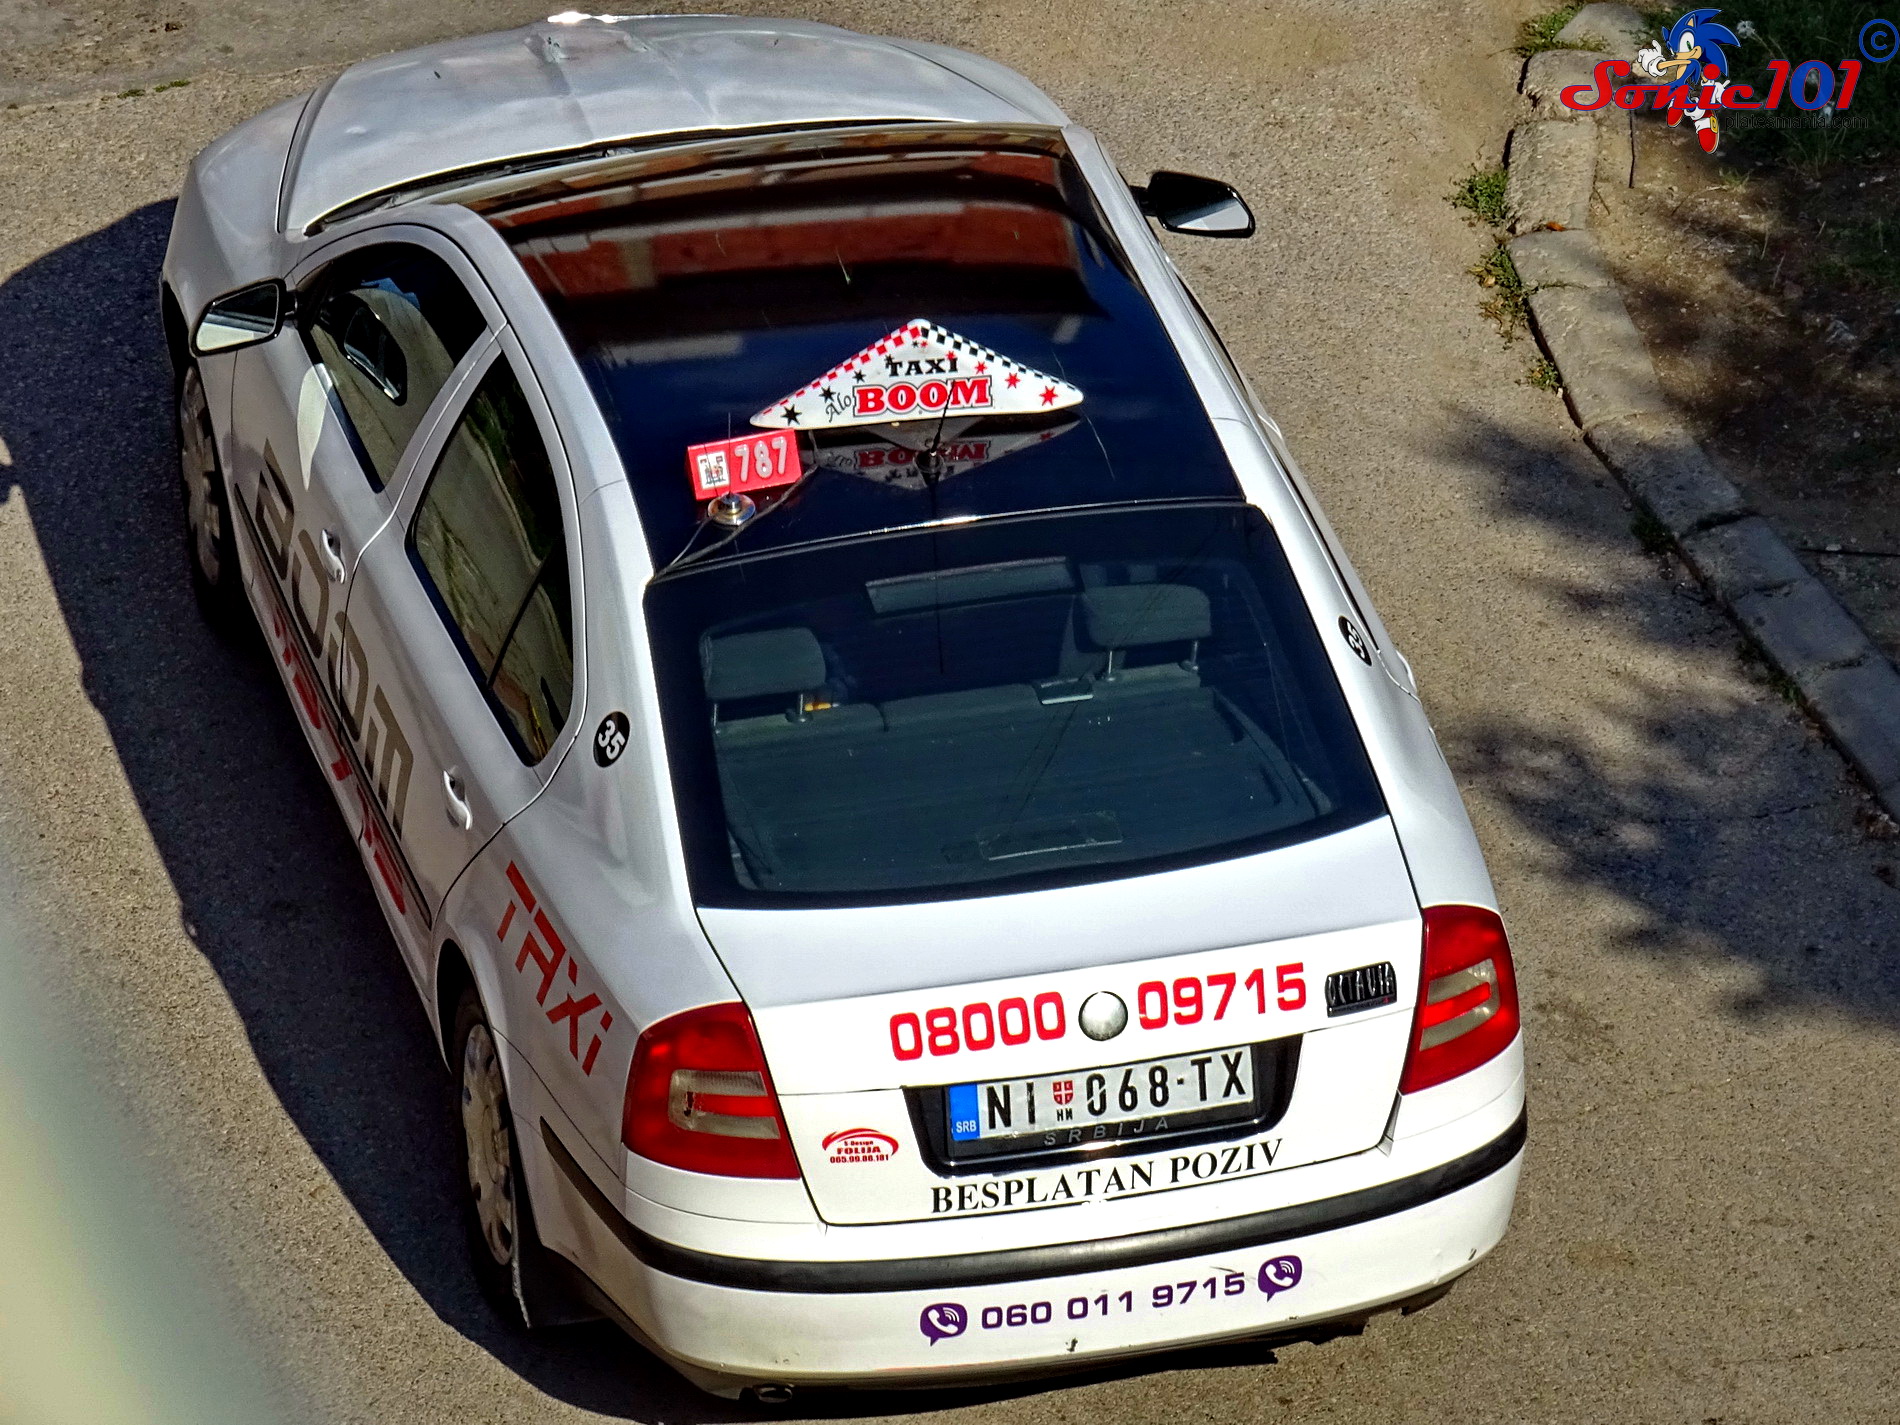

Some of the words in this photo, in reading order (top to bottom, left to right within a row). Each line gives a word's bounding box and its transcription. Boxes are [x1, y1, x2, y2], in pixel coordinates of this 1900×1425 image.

[886, 357, 959, 377] TAXI
[825, 392, 852, 423] Alo
[853, 376, 993, 418] BOOM
[734, 436, 788, 482] 787
[598, 719, 626, 760] 35
[889, 991, 1066, 1061] 08000
[1137, 962, 1307, 1030] 09715
[955, 1119, 978, 1134] SRB
[986, 1081, 1037, 1130] NI
[836, 1146, 881, 1155] FOLIJA
[1043, 1116, 1169, 1146] SRBIJA
[930, 1161, 1155, 1214] BESPLATAN
[1169, 1138, 1284, 1184] POZIV
[981, 1301, 1052, 1329] 060
[1066, 1290, 1133, 1320] 011
[1151, 1271, 1246, 1309] 9715
